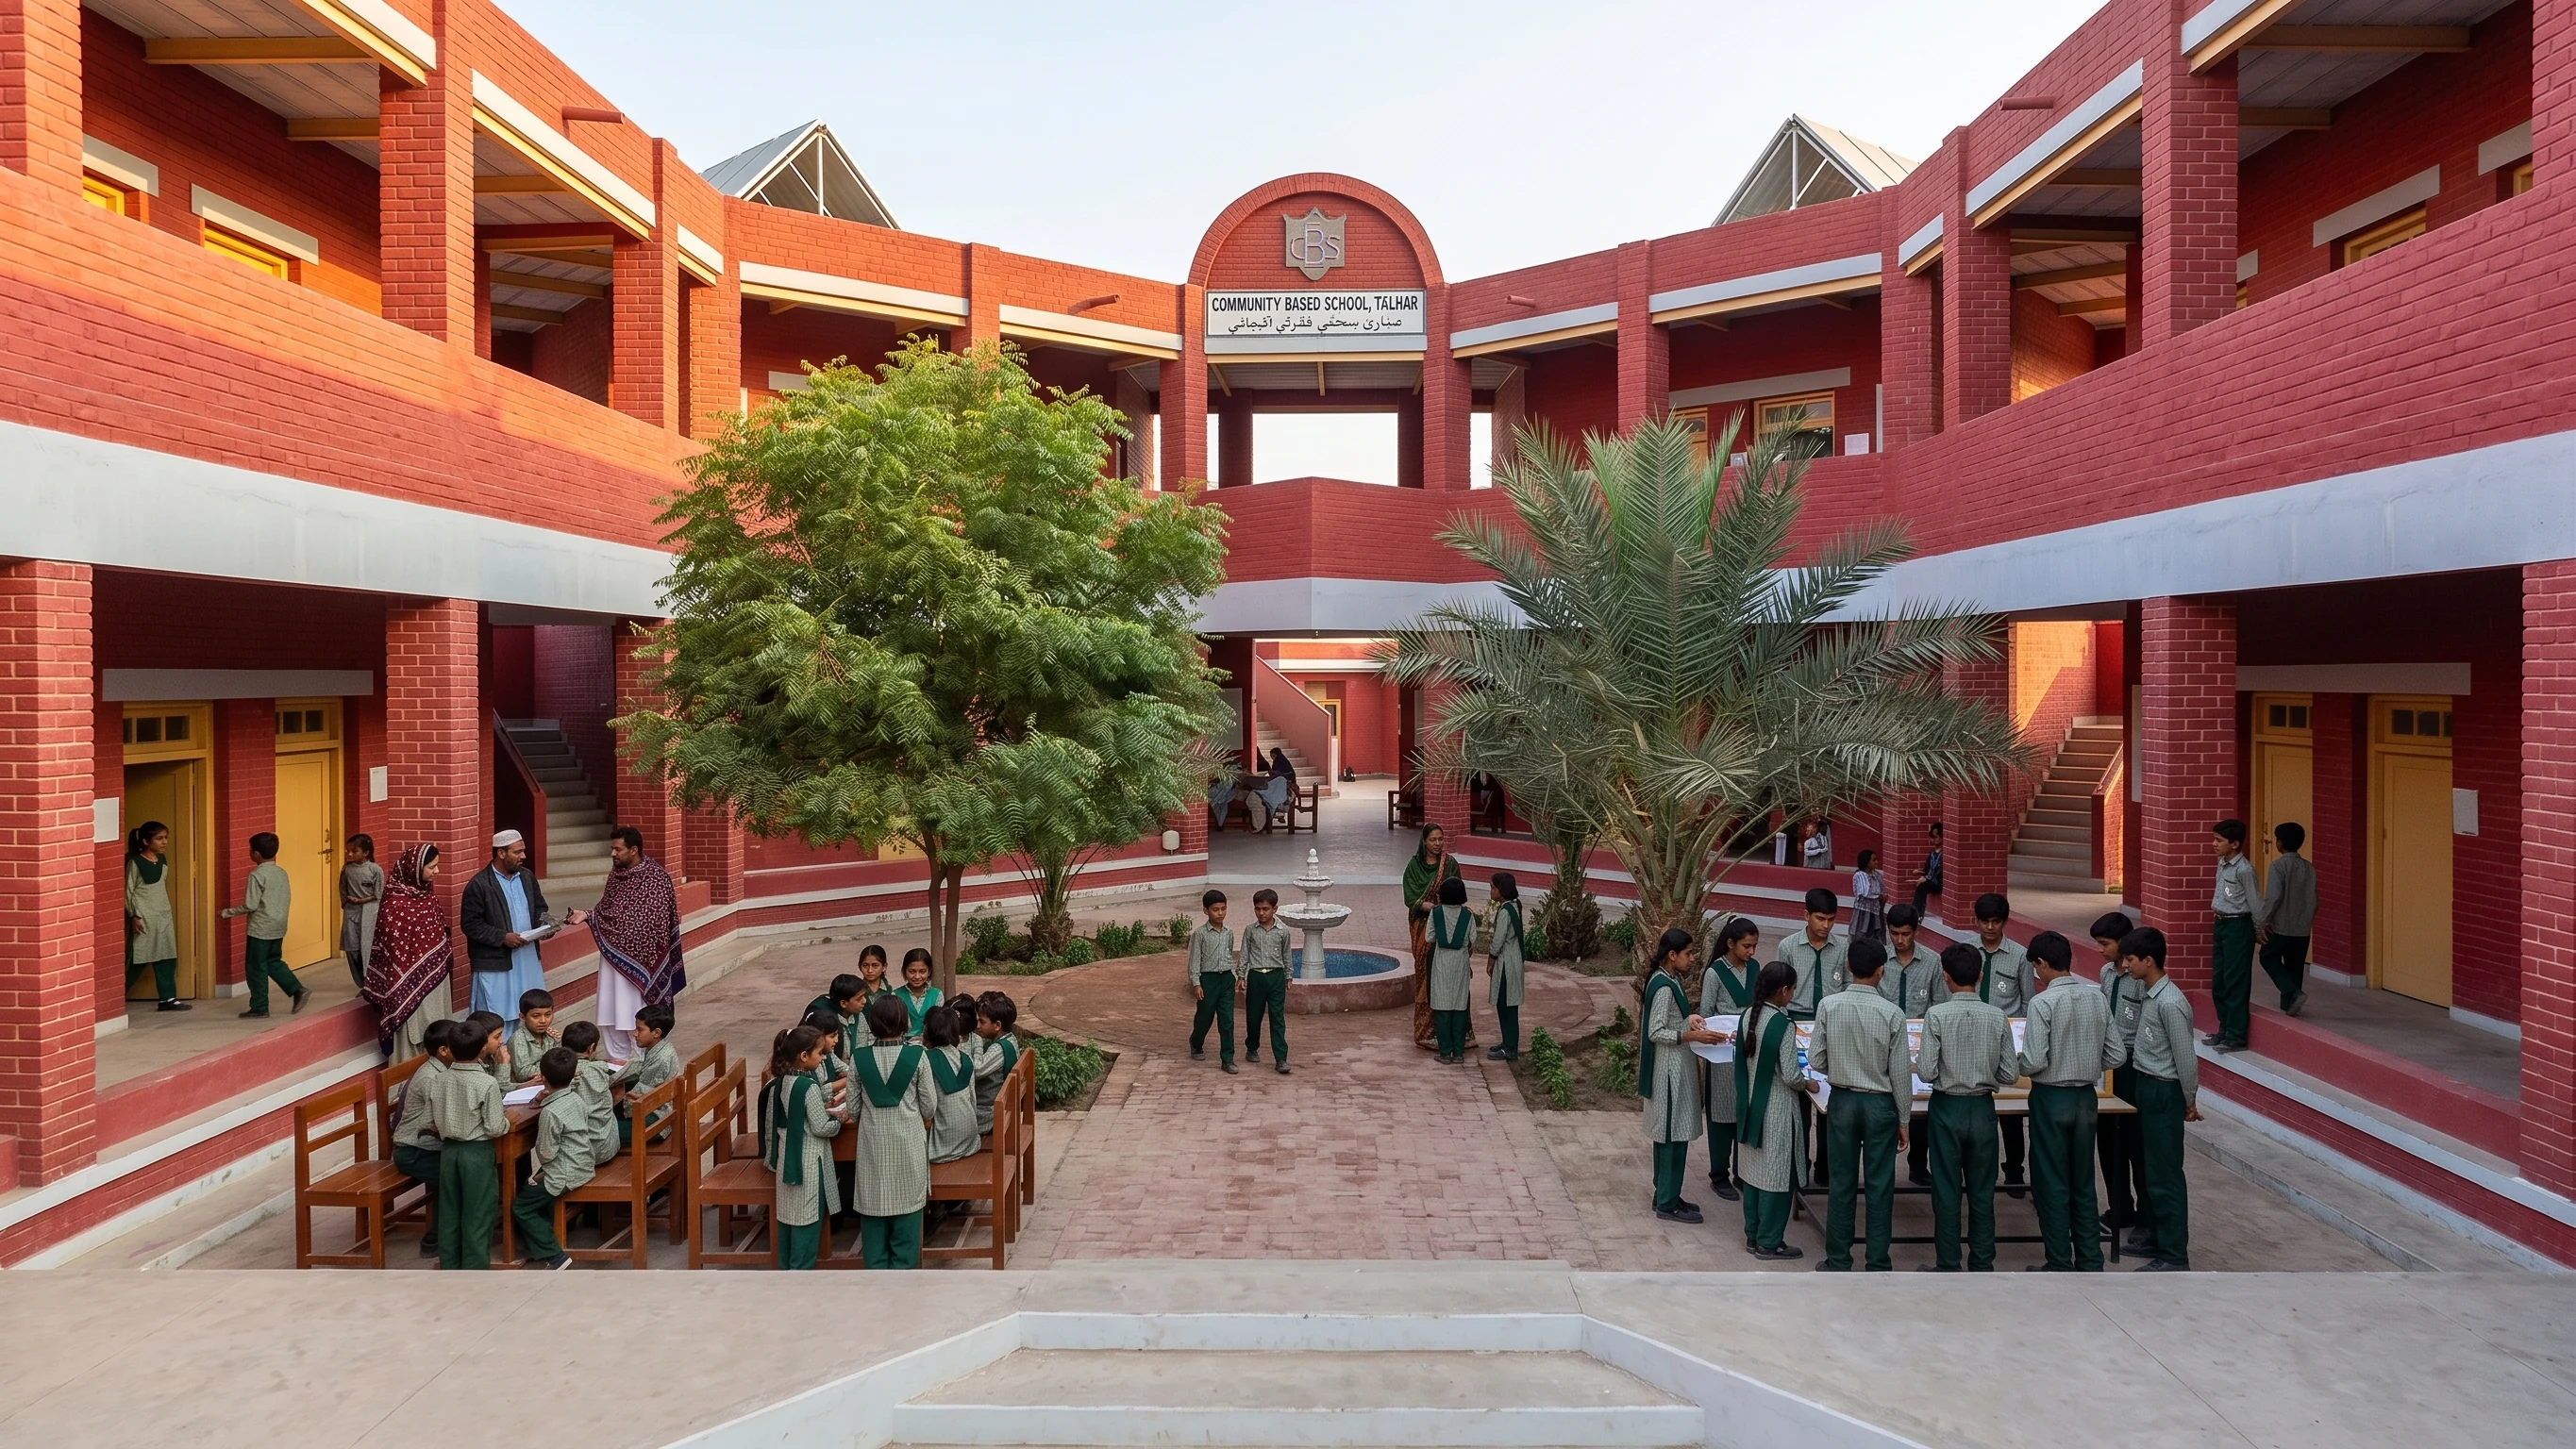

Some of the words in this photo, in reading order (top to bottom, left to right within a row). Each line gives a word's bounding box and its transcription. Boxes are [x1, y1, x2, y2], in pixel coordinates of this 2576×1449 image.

[1212, 296, 1281, 311] COMMUNITY
[1284, 296, 1321, 311] BASED
[1324, 295, 1371, 314] SCHOOL,
[1374, 295, 1418, 310] TALHAR
